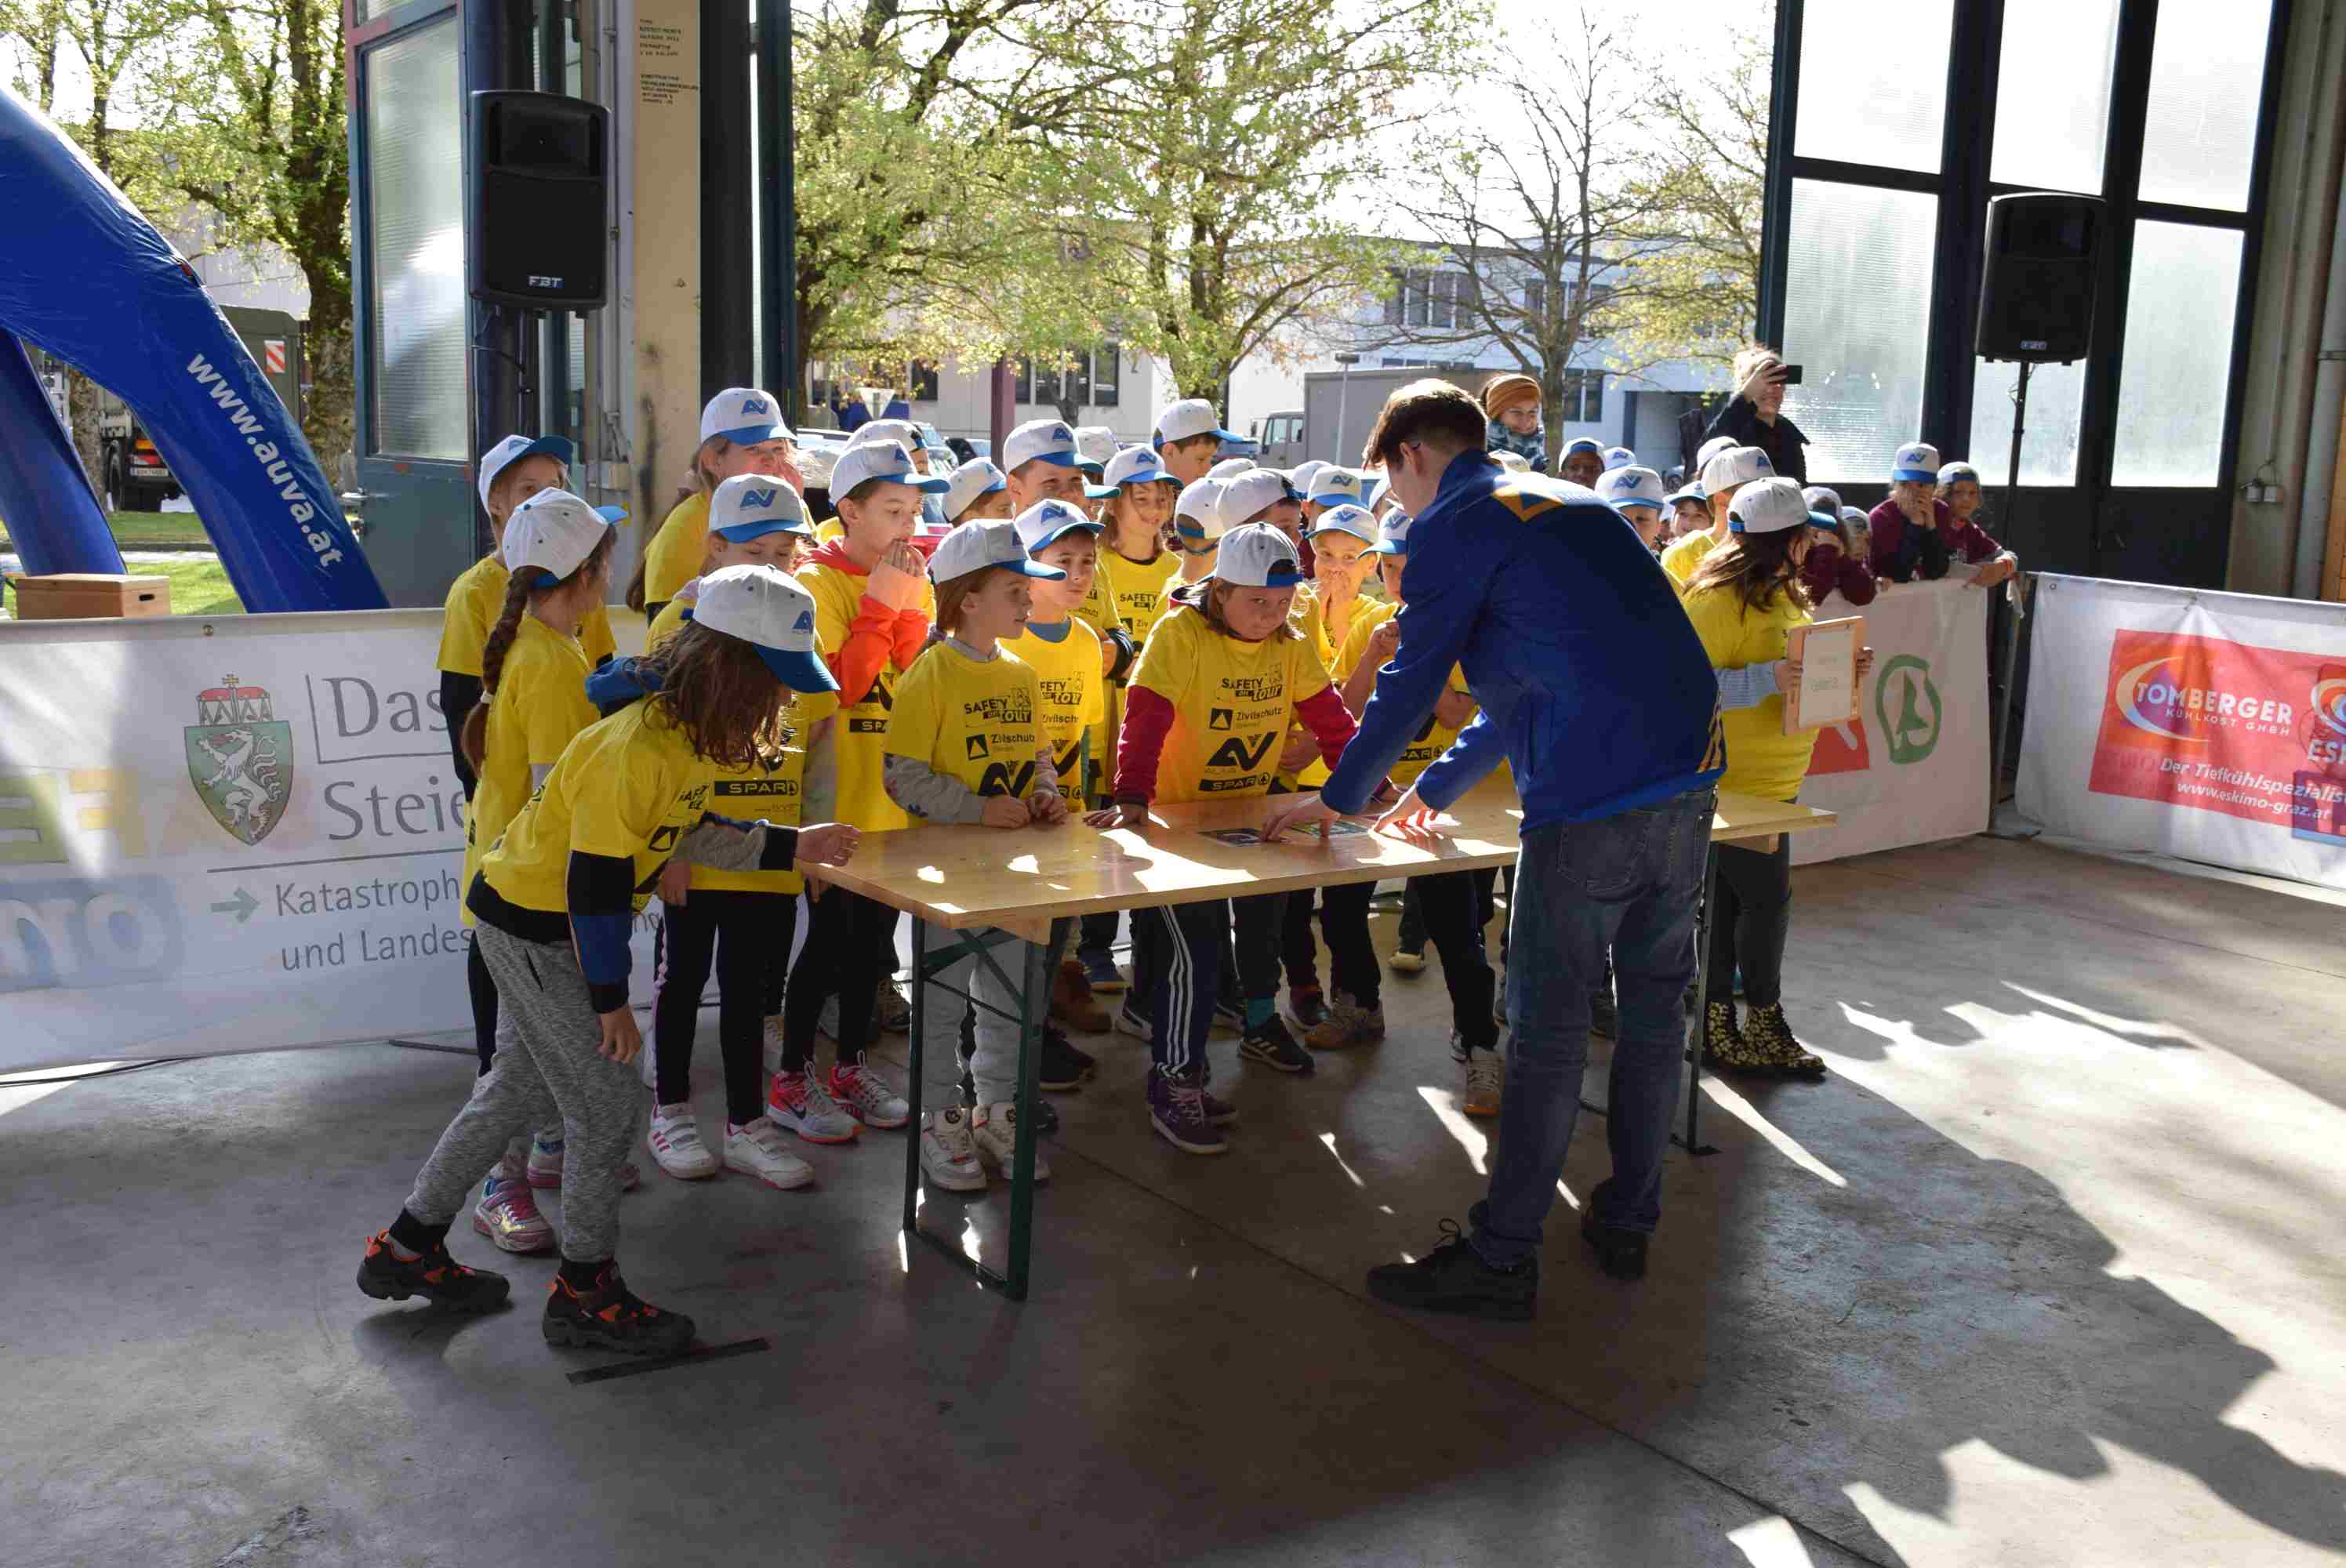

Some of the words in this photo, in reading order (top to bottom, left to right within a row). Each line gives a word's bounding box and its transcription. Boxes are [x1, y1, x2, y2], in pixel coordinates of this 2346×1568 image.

[529, 275, 563, 288] FBT
[187, 354, 343, 567] www.auva.at
[1120, 593, 1158, 602] SAFETY
[1222, 677, 1263, 690] SAFETY
[321, 677, 448, 737] Das
[964, 698, 1008, 714] SAFETY
[2135, 682, 2293, 724] TOMBERGER
[2160, 757, 2188, 774] Der
[729, 782, 786, 794] SPAR
[1211, 775, 1255, 791] SPAR
[2177, 783, 2332, 818] www.eskimo-graz.at
[276, 869, 460, 916] Katastroph
[282, 932, 345, 971] und
